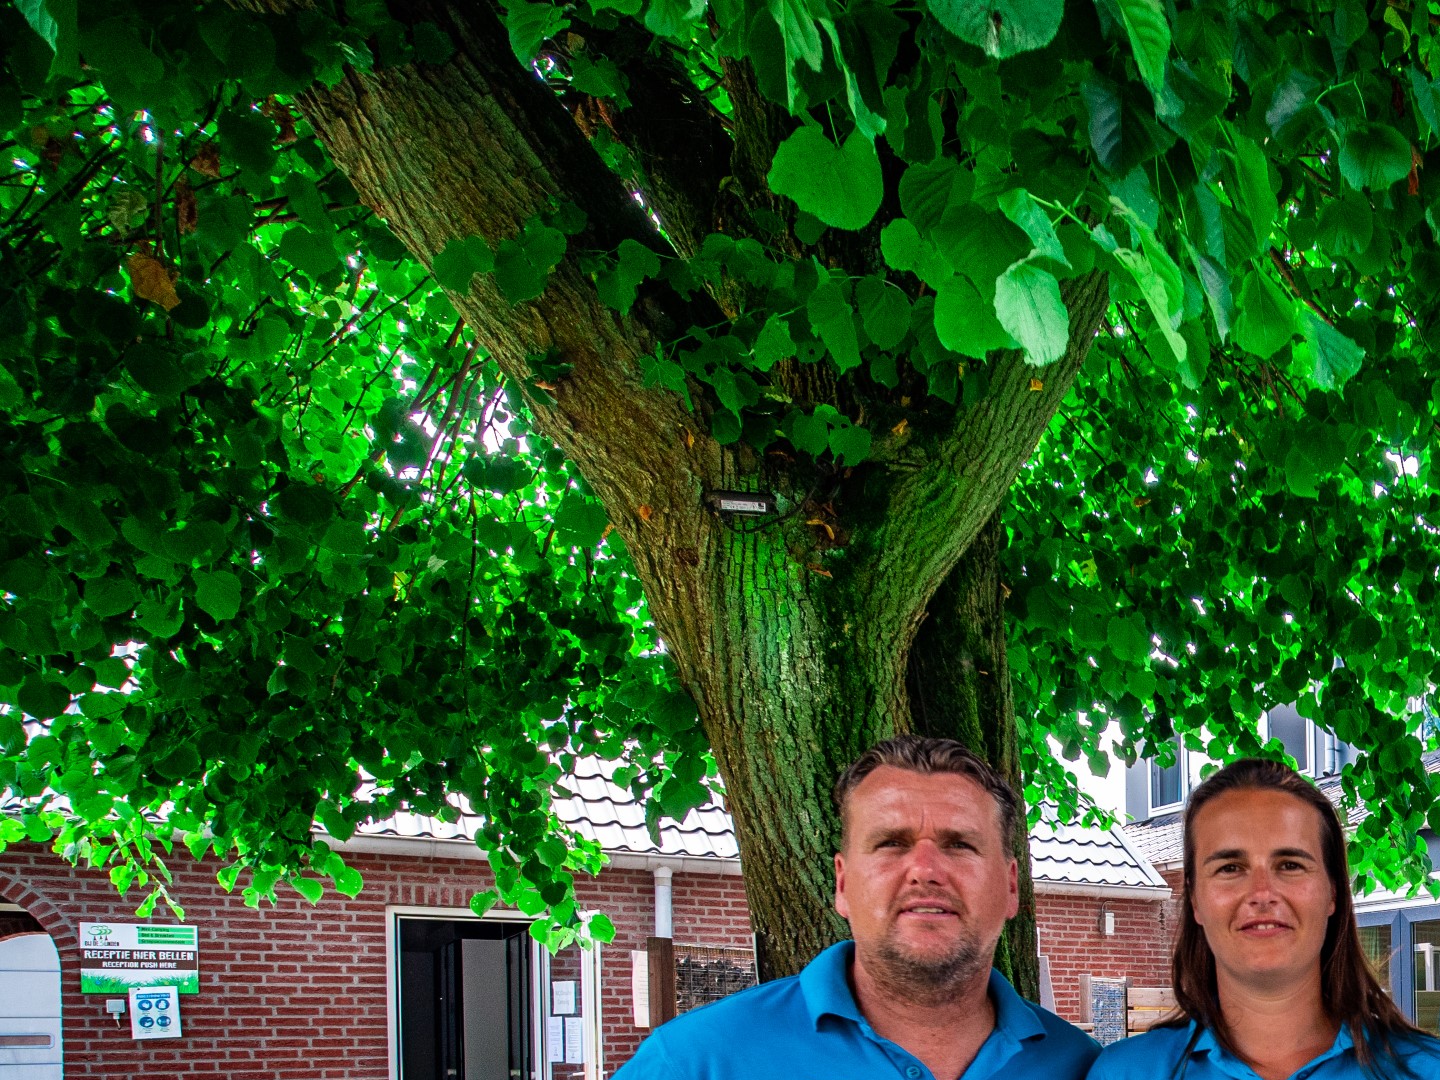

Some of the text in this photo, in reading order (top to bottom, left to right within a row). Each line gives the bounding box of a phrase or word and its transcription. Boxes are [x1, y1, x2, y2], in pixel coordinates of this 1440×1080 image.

[84, 950, 194, 961] RECEPTIE HIER BELLEN
[140, 961, 158, 969] PUSH
